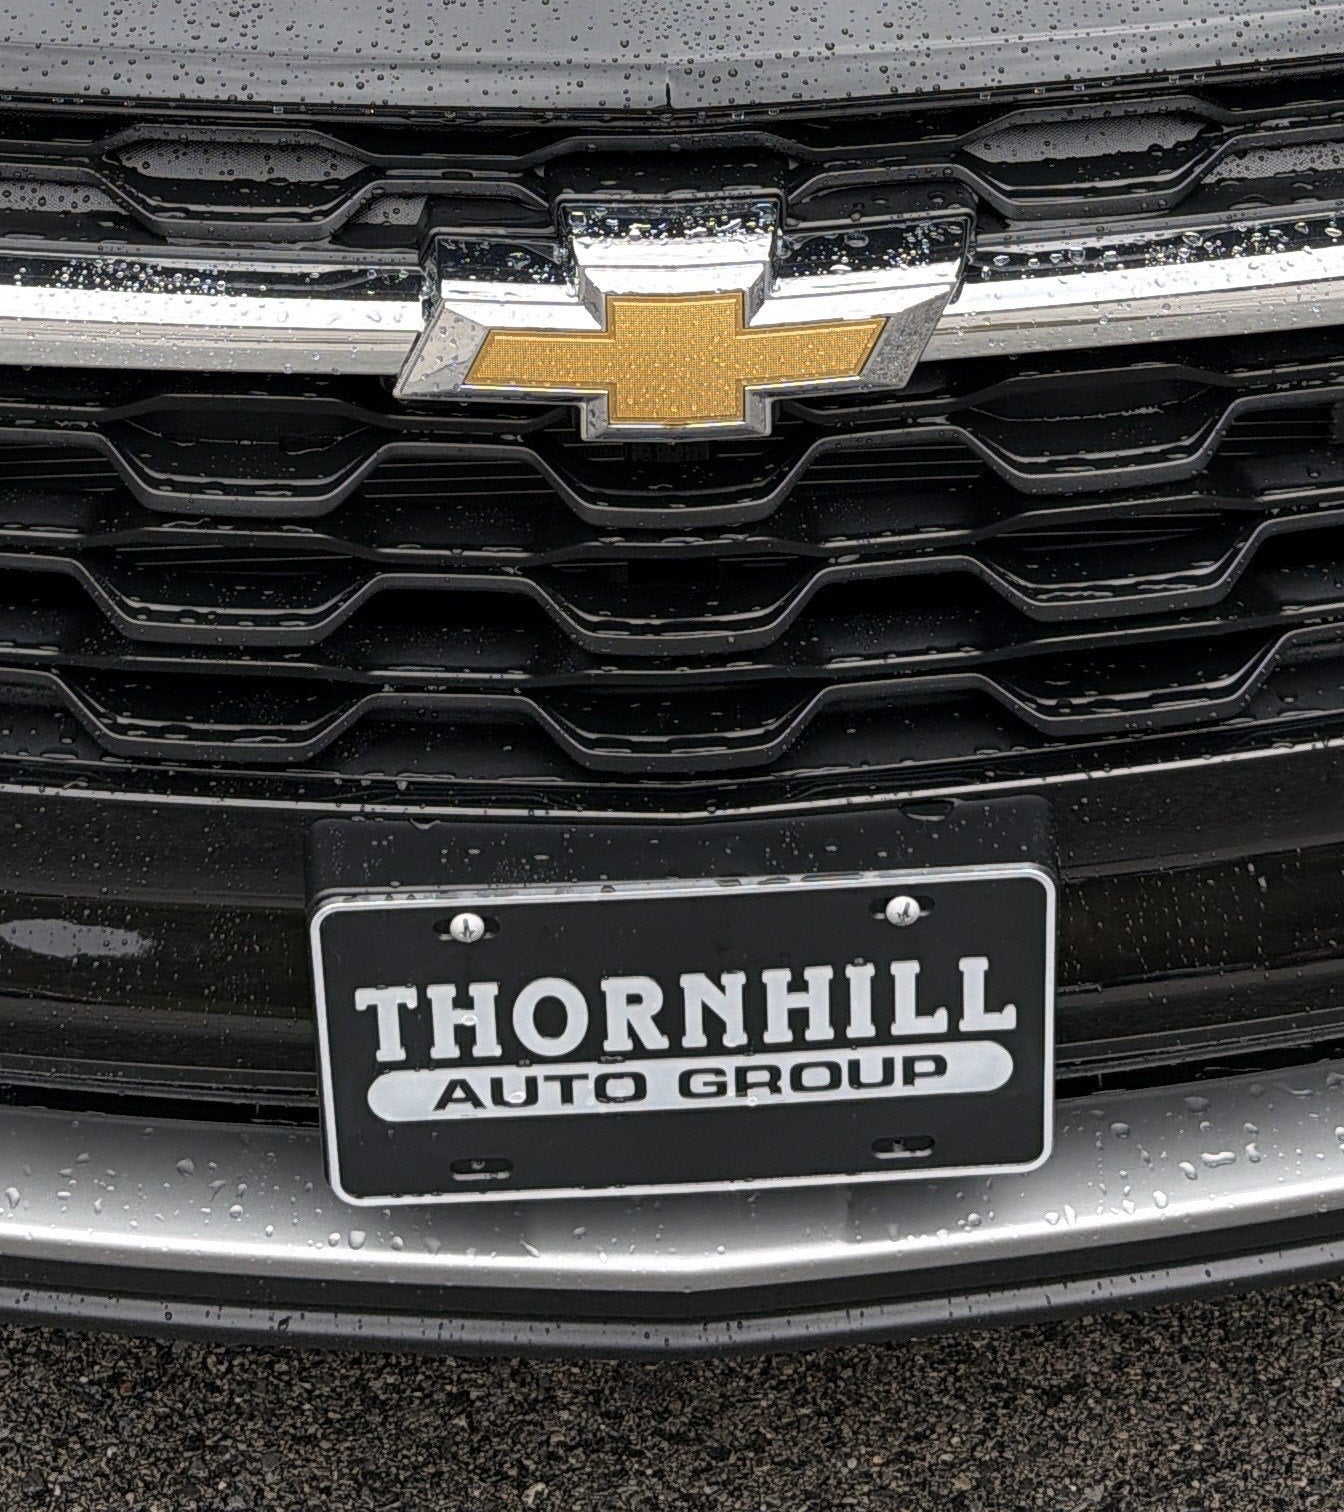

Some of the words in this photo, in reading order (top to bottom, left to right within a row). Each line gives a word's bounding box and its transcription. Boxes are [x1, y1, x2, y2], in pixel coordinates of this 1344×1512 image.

[354, 956, 1017, 1062] THORNHILL
[433, 1070, 648, 1112] AUTO
[678, 1054, 948, 1102] GROUP
